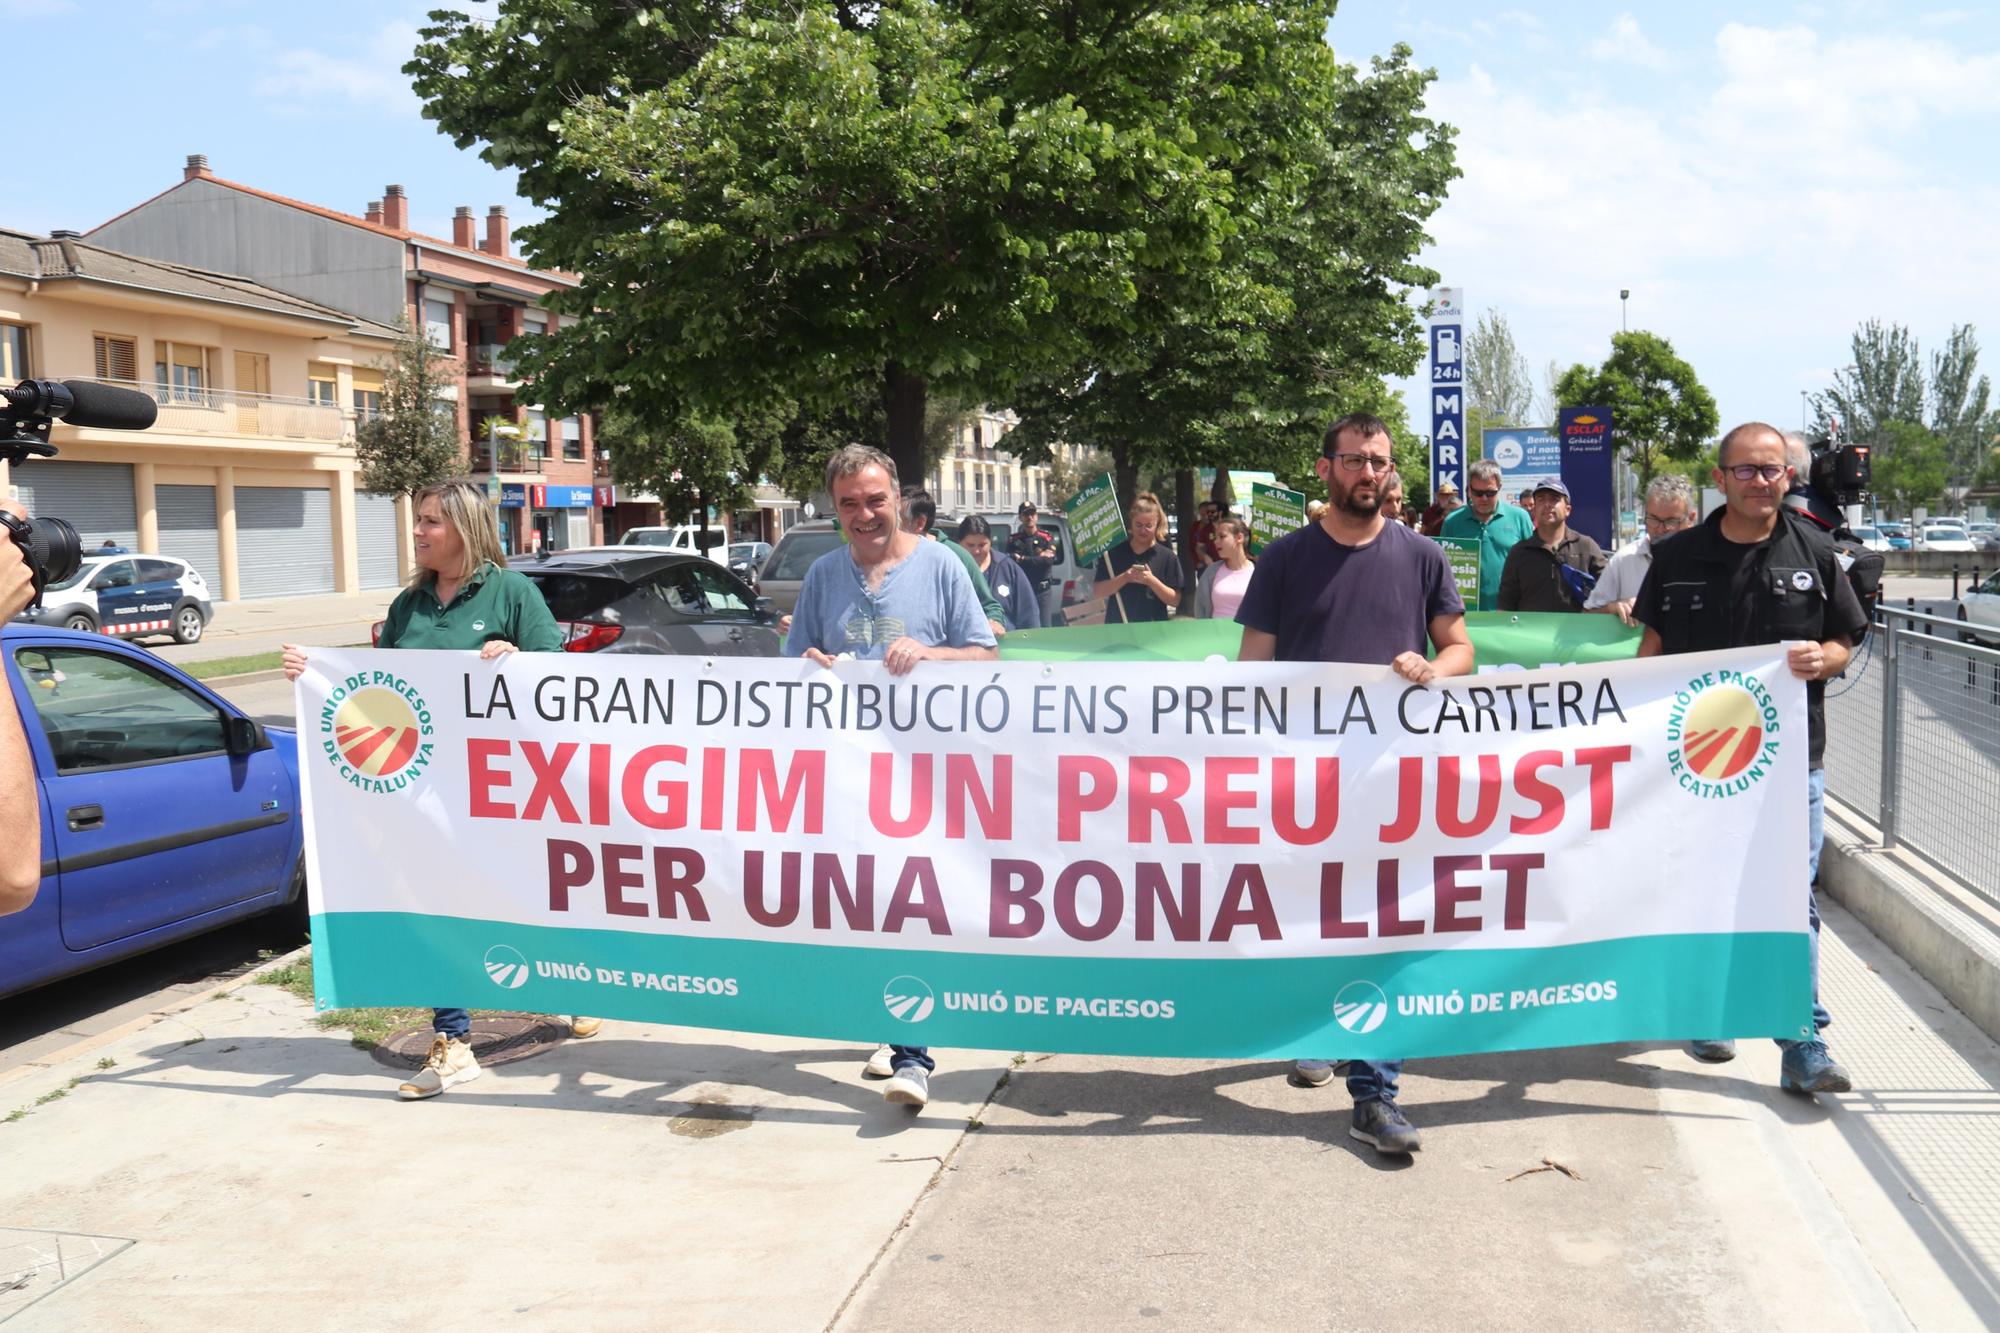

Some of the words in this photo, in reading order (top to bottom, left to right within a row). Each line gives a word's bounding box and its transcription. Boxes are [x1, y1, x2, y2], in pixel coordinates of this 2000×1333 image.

[1432, 307, 1461, 317] Condis
[1433, 366, 1461, 379] 24h
[1435, 394, 1460, 490] MARK
[1566, 424, 1606, 435] ESCLAT
[1072, 522, 1083, 533] La
[1083, 500, 1115, 526] pagesia
[1076, 529, 1091, 545] diu
[1093, 509, 1119, 536] prou!
[1253, 507, 1264, 517] La
[1265, 511, 1301, 528] pagesia
[1253, 520, 1270, 533] diu
[1451, 563, 1477, 574] esia
[1455, 578, 1477, 588] ou!
[321, 685, 347, 733] UNIÓ
[345, 671, 370, 692] DE
[373, 670, 434, 736] PAGESOS
[463, 673, 516, 720] LA
[534, 675, 676, 726] GRAN
[696, 673, 1010, 733] DISTRIBUCIÓ
[1032, 684, 1129, 734] ENS
[1151, 685, 1288, 735] PREN
[1313, 685, 1377, 735] LA
[1397, 677, 1628, 734] CARTERA
[1667, 690, 1691, 741] UNIÓ
[1688, 672, 1716, 694] DE
[1718, 669, 1780, 733] PAGESOS
[322, 740, 342, 766] DE
[340, 743, 434, 794] CATALUNYA
[1667, 748, 1684, 776] DE
[1679, 741, 1780, 799] CATALUNYA
[466, 738, 826, 836] EXIGIM
[868, 752, 1013, 840] UN
[1057, 755, 1340, 845] PREU
[1378, 744, 1632, 844] JUST
[546, 838, 710, 922] PER
[743, 849, 953, 936] UNA
[988, 858, 1283, 942] BONA
[1320, 852, 1545, 940] LLET
[536, 960, 592, 984] UNIÓ
[597, 968, 627, 987] DE
[631, 971, 739, 997] PAGESOS
[943, 990, 1008, 1013] UNIÓ
[1014, 995, 1049, 1015] DE
[1054, 997, 1176, 1019] PAGESOS
[1397, 989, 1464, 1016] UNIÓ
[1470, 991, 1503, 1013] DE
[1509, 980, 1618, 1011] PAGESOS
